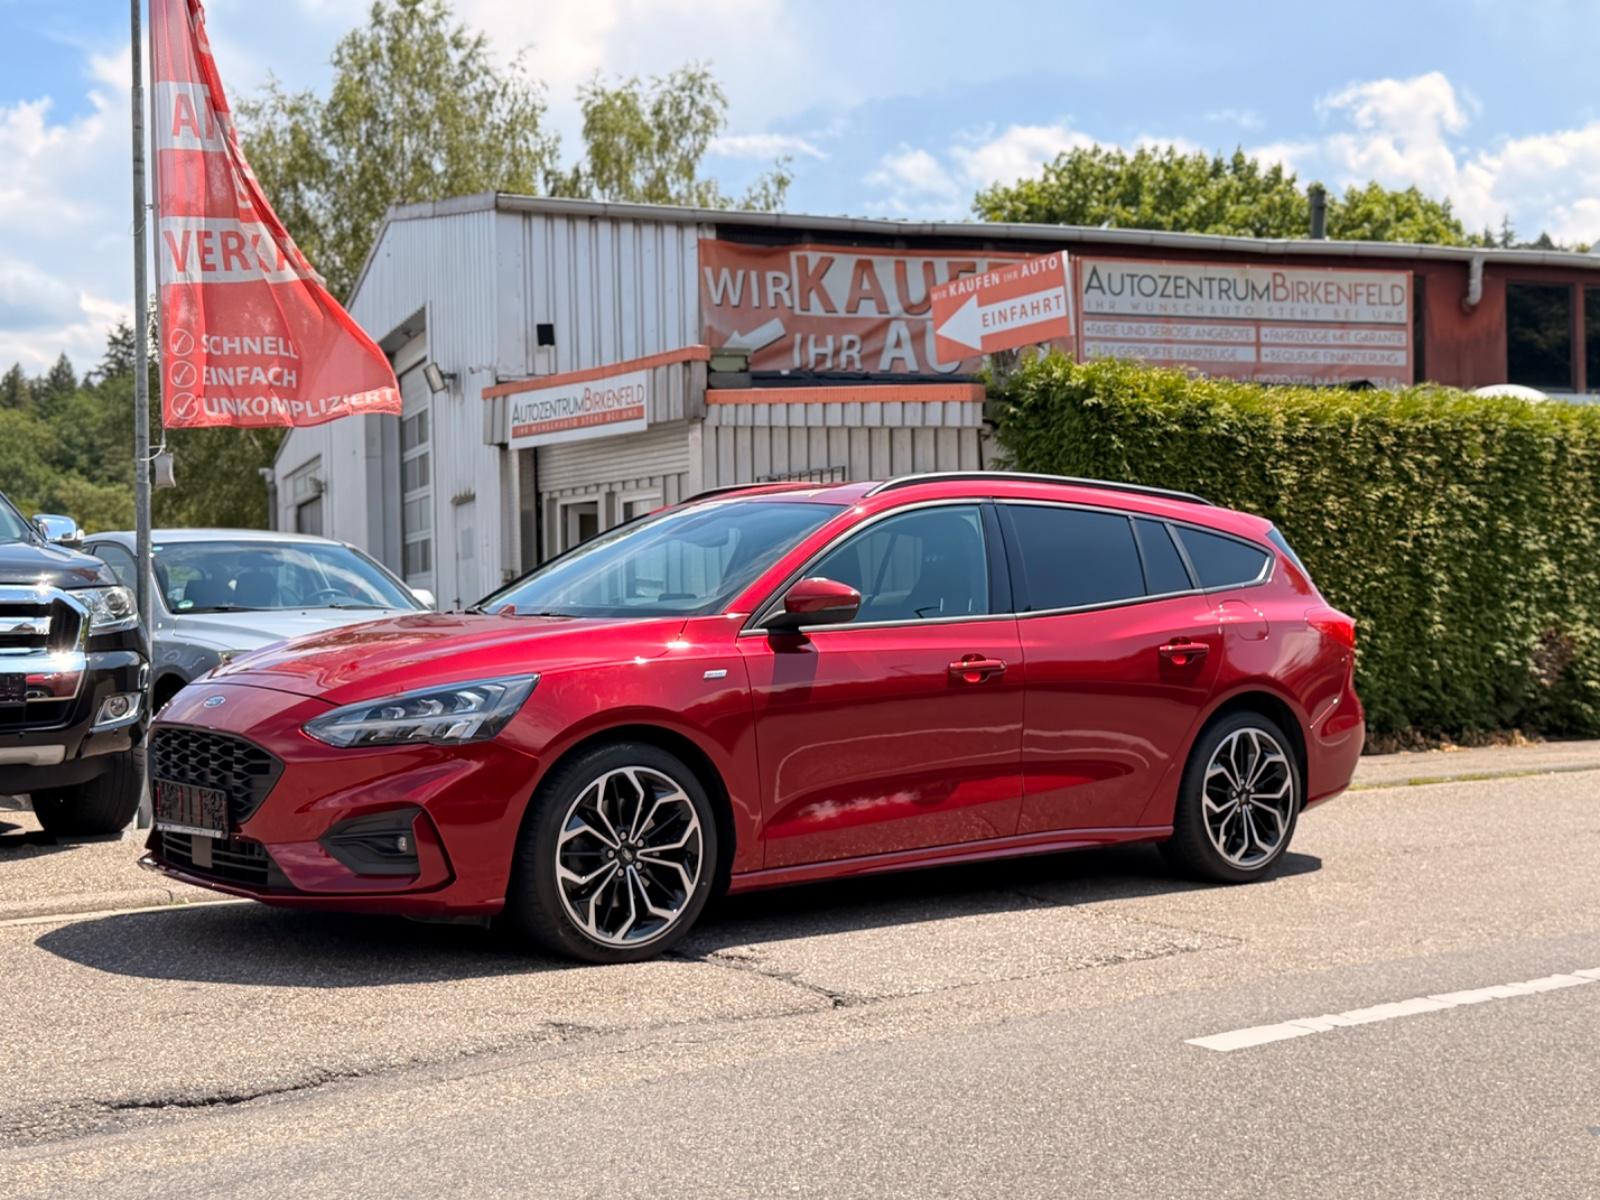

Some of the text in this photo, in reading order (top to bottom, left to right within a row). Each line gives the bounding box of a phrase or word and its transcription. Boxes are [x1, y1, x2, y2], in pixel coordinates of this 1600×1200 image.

[704, 265, 794, 310] WIR
[948, 272, 1000, 297] KAUFEN
[1003, 271, 1019, 282] IHR
[1020, 256, 1058, 278] AUTO
[981, 294, 1062, 328] EINFAHRT
[1086, 299, 1117, 311] IHR
[1130, 301, 1255, 317] WUNSCHAUTO
[1267, 306, 1320, 318] STEHT
[202, 334, 299, 360] SCHNELL
[792, 331, 863, 371] IHR
[202, 365, 297, 388] EINFACH
[203, 387, 396, 418] UNKOMPLIZIERT
